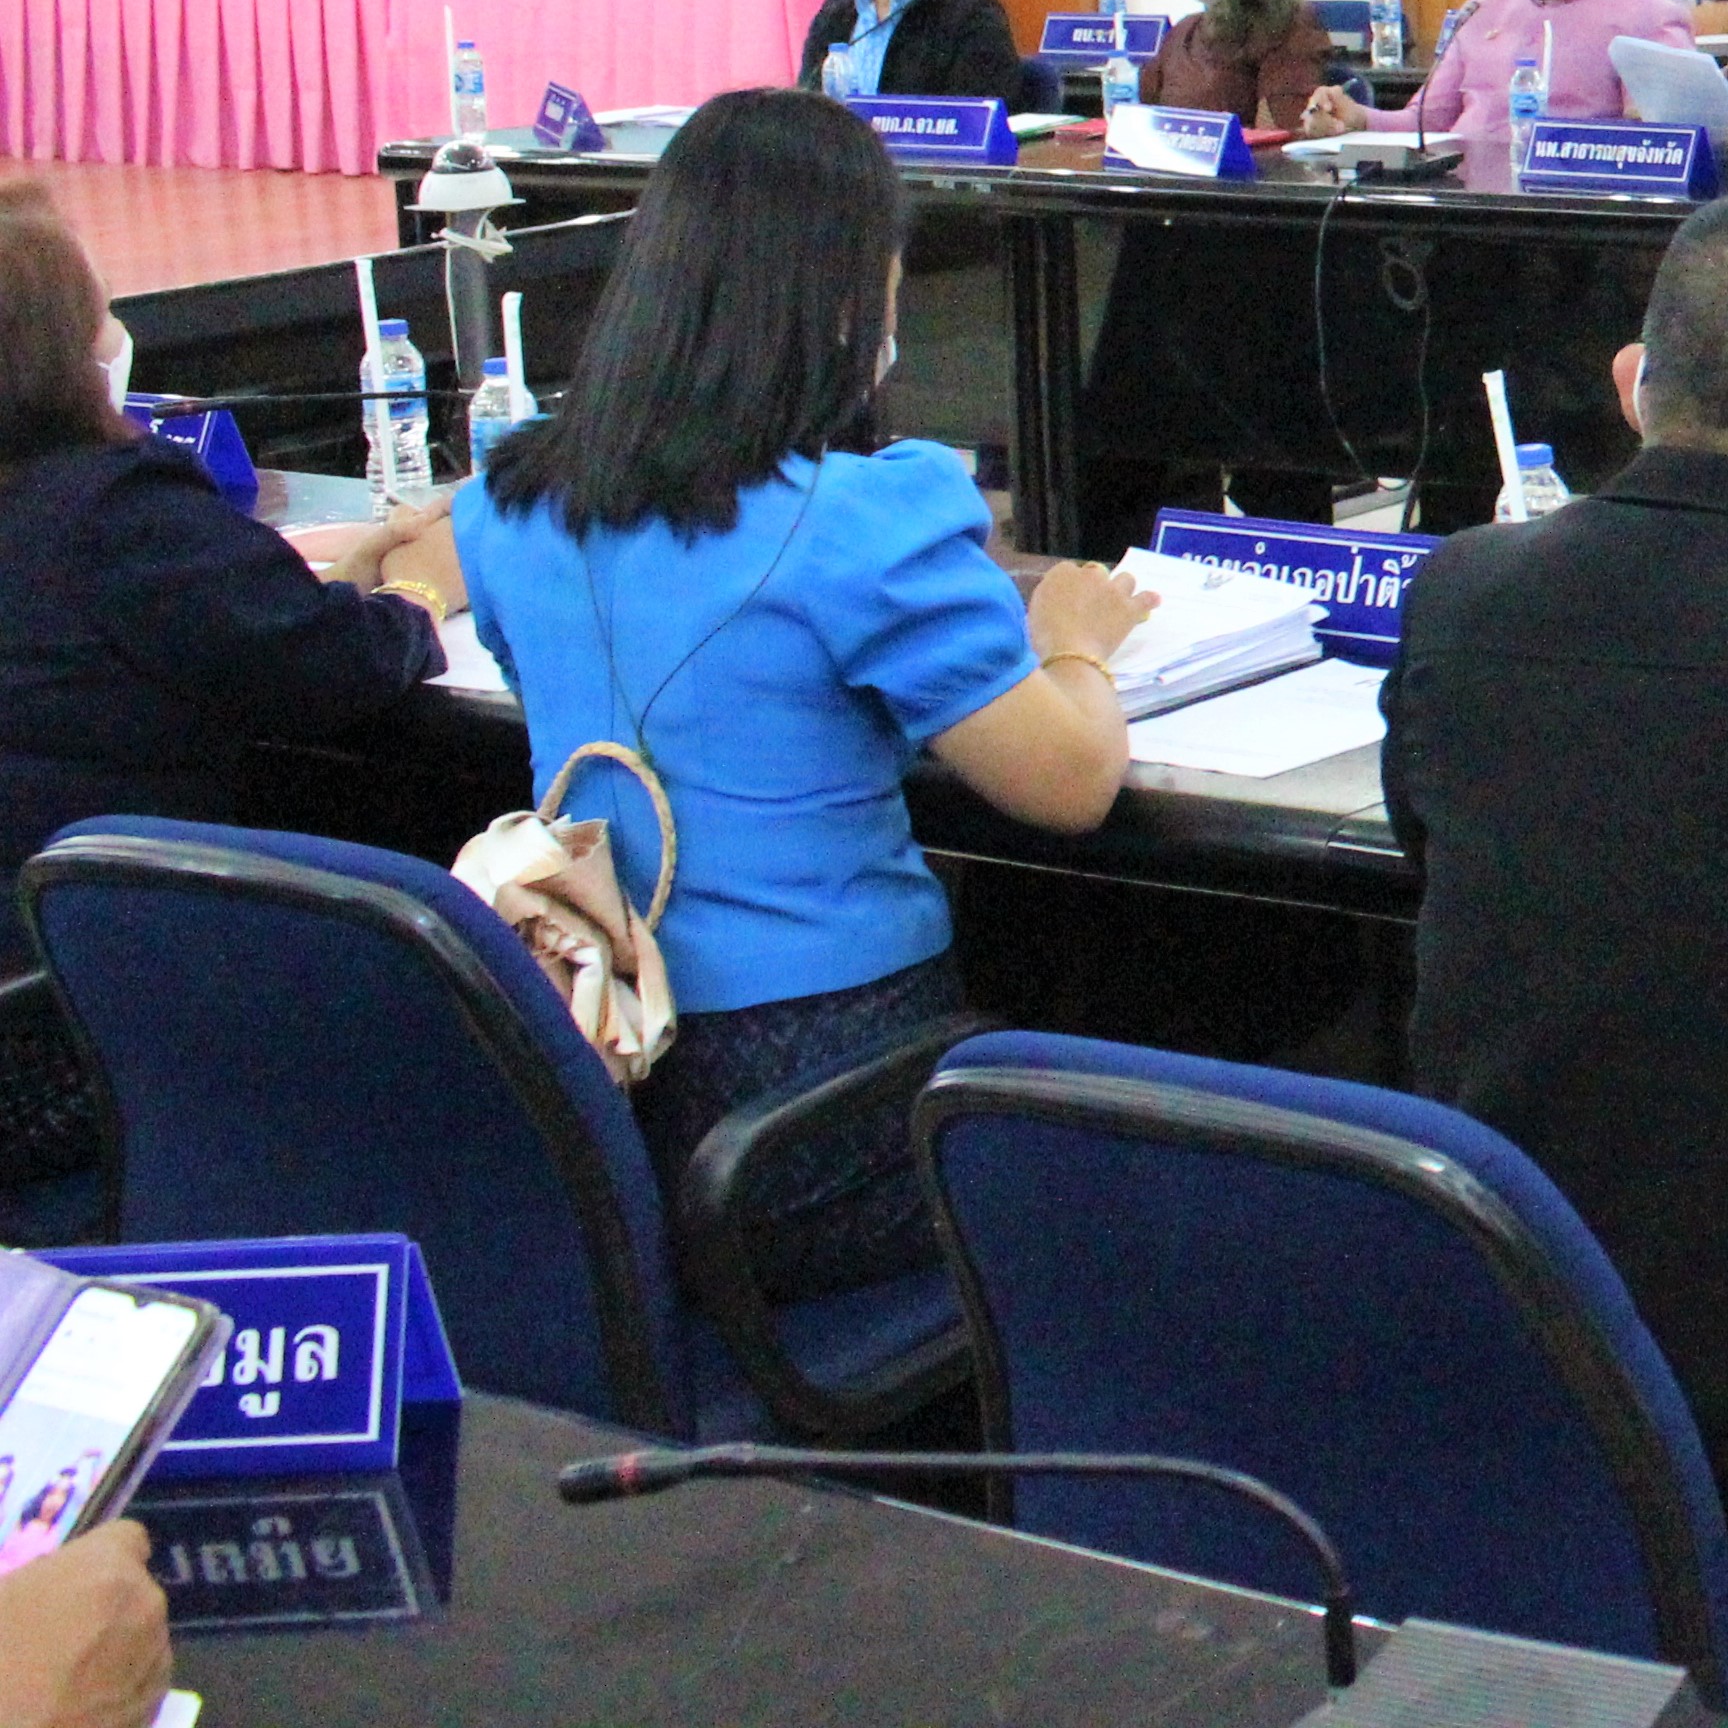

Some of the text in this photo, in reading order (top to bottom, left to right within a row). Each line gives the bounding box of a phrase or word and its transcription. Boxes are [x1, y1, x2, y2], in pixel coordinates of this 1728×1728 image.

[1535, 138, 1683, 169] นพ.สาธารณสุขจังหวัด
